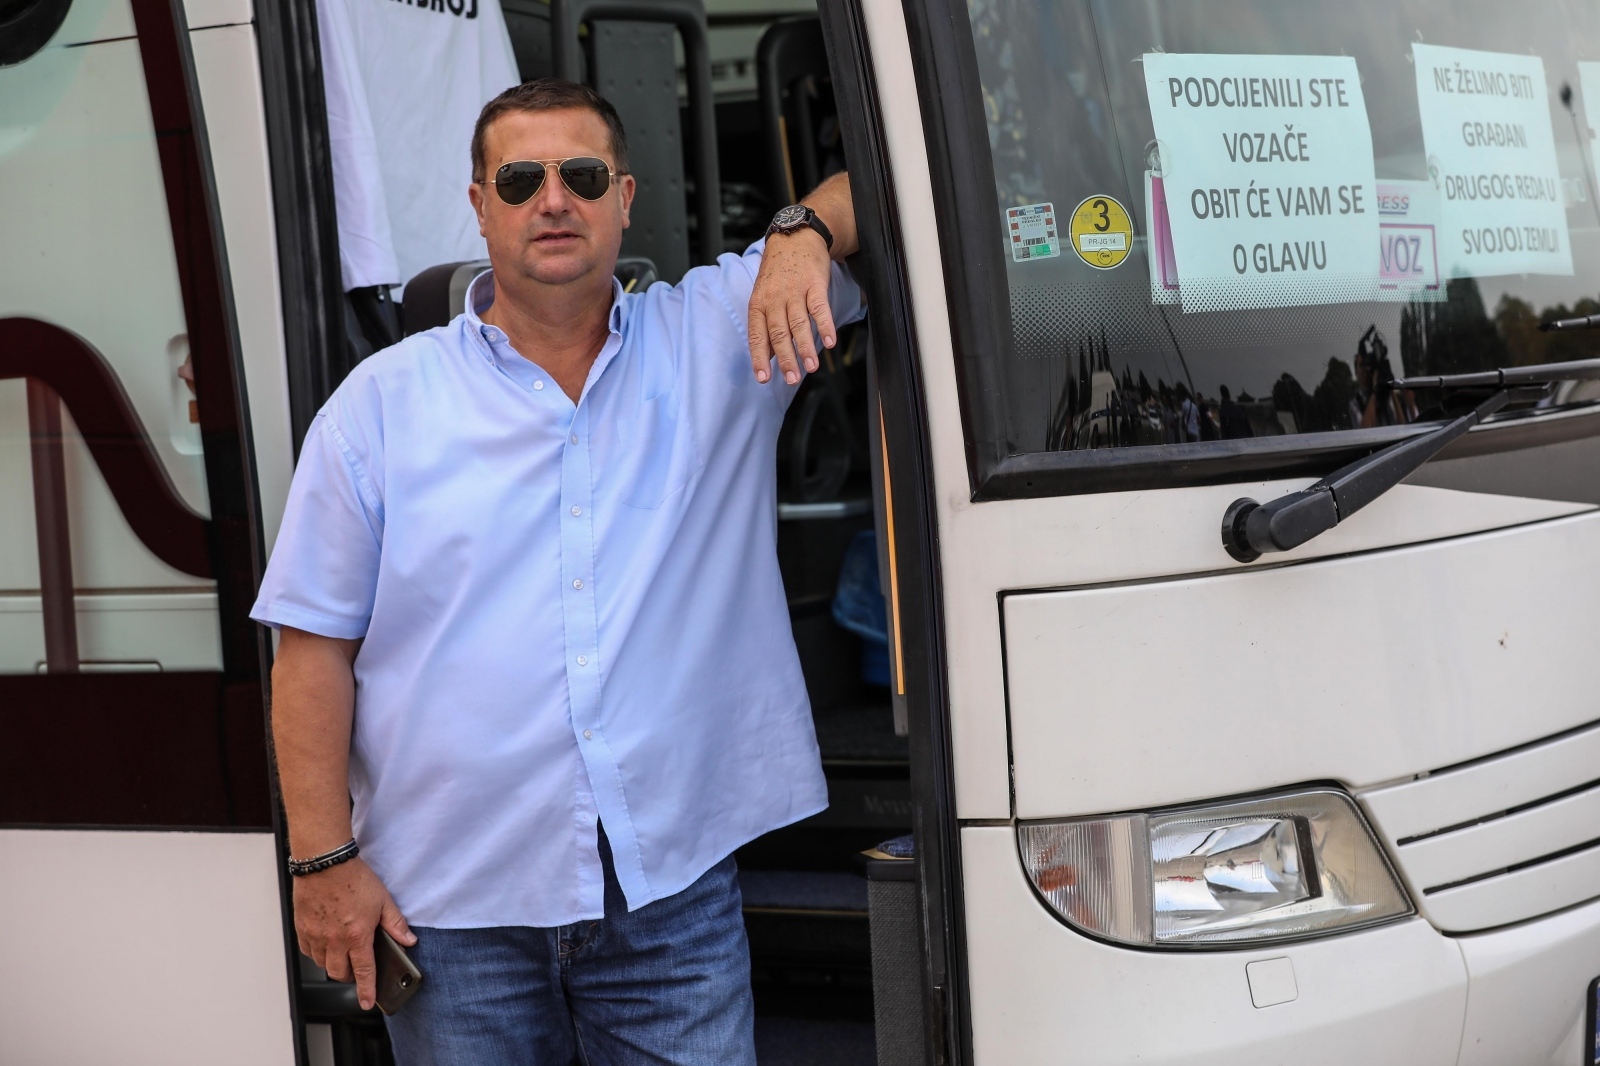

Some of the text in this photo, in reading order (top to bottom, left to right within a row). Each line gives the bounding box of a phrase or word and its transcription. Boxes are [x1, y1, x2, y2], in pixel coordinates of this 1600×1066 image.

[1168, 77, 1349, 108] PODCIJENILI STE
[1433, 61, 1534, 99] NE ŽELIMO BITI
[1222, 124, 1310, 163] VOZAČE
[1462, 121, 1528, 149] GRAĐANI
[1191, 180, 1365, 219] OBIT ĆE VAM SE
[1445, 174, 1556, 202] DRUGOG REDA U
[1092, 199, 1111, 232] 3
[1233, 240, 1327, 274] O GLAVU
[1462, 226, 1523, 255] SVOJOJ
